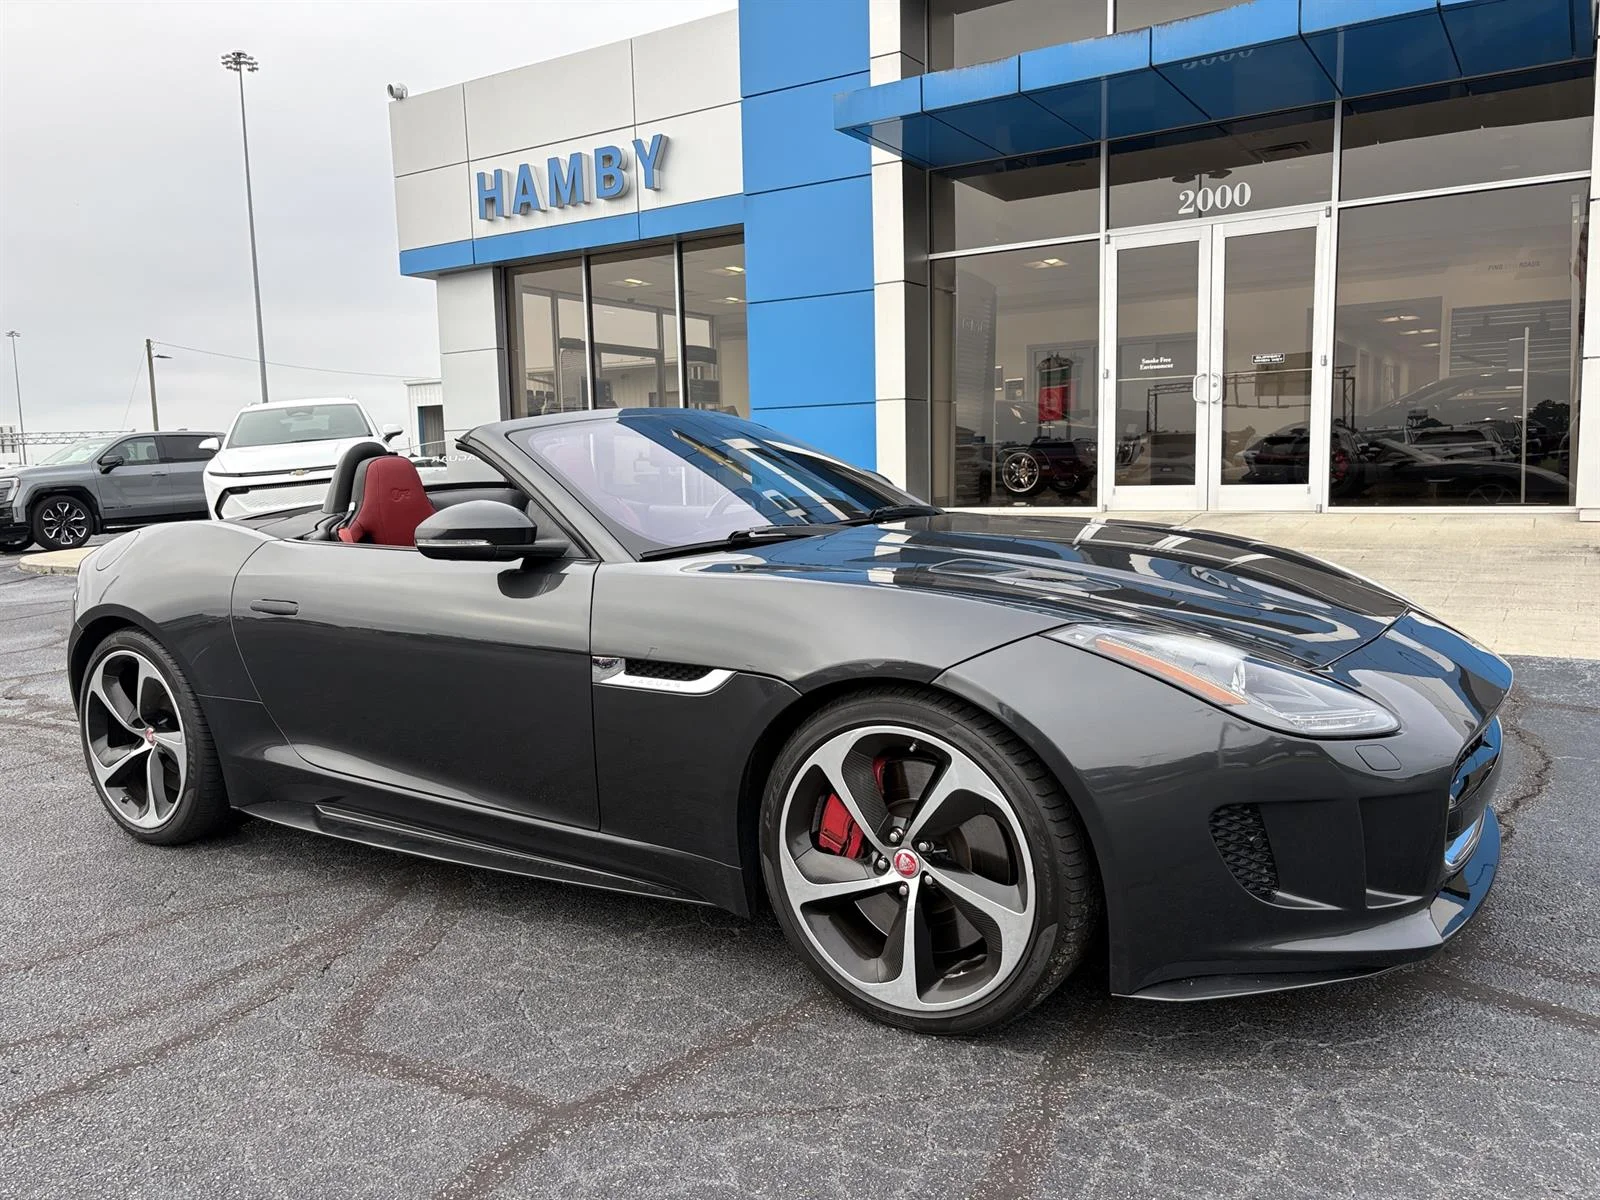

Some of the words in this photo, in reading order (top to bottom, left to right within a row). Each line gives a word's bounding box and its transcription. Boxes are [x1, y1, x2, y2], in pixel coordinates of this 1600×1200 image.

[477, 133, 668, 220] HAMBY
[1178, 182, 1251, 215] 2000
[1139, 363, 1174, 371] Environment
